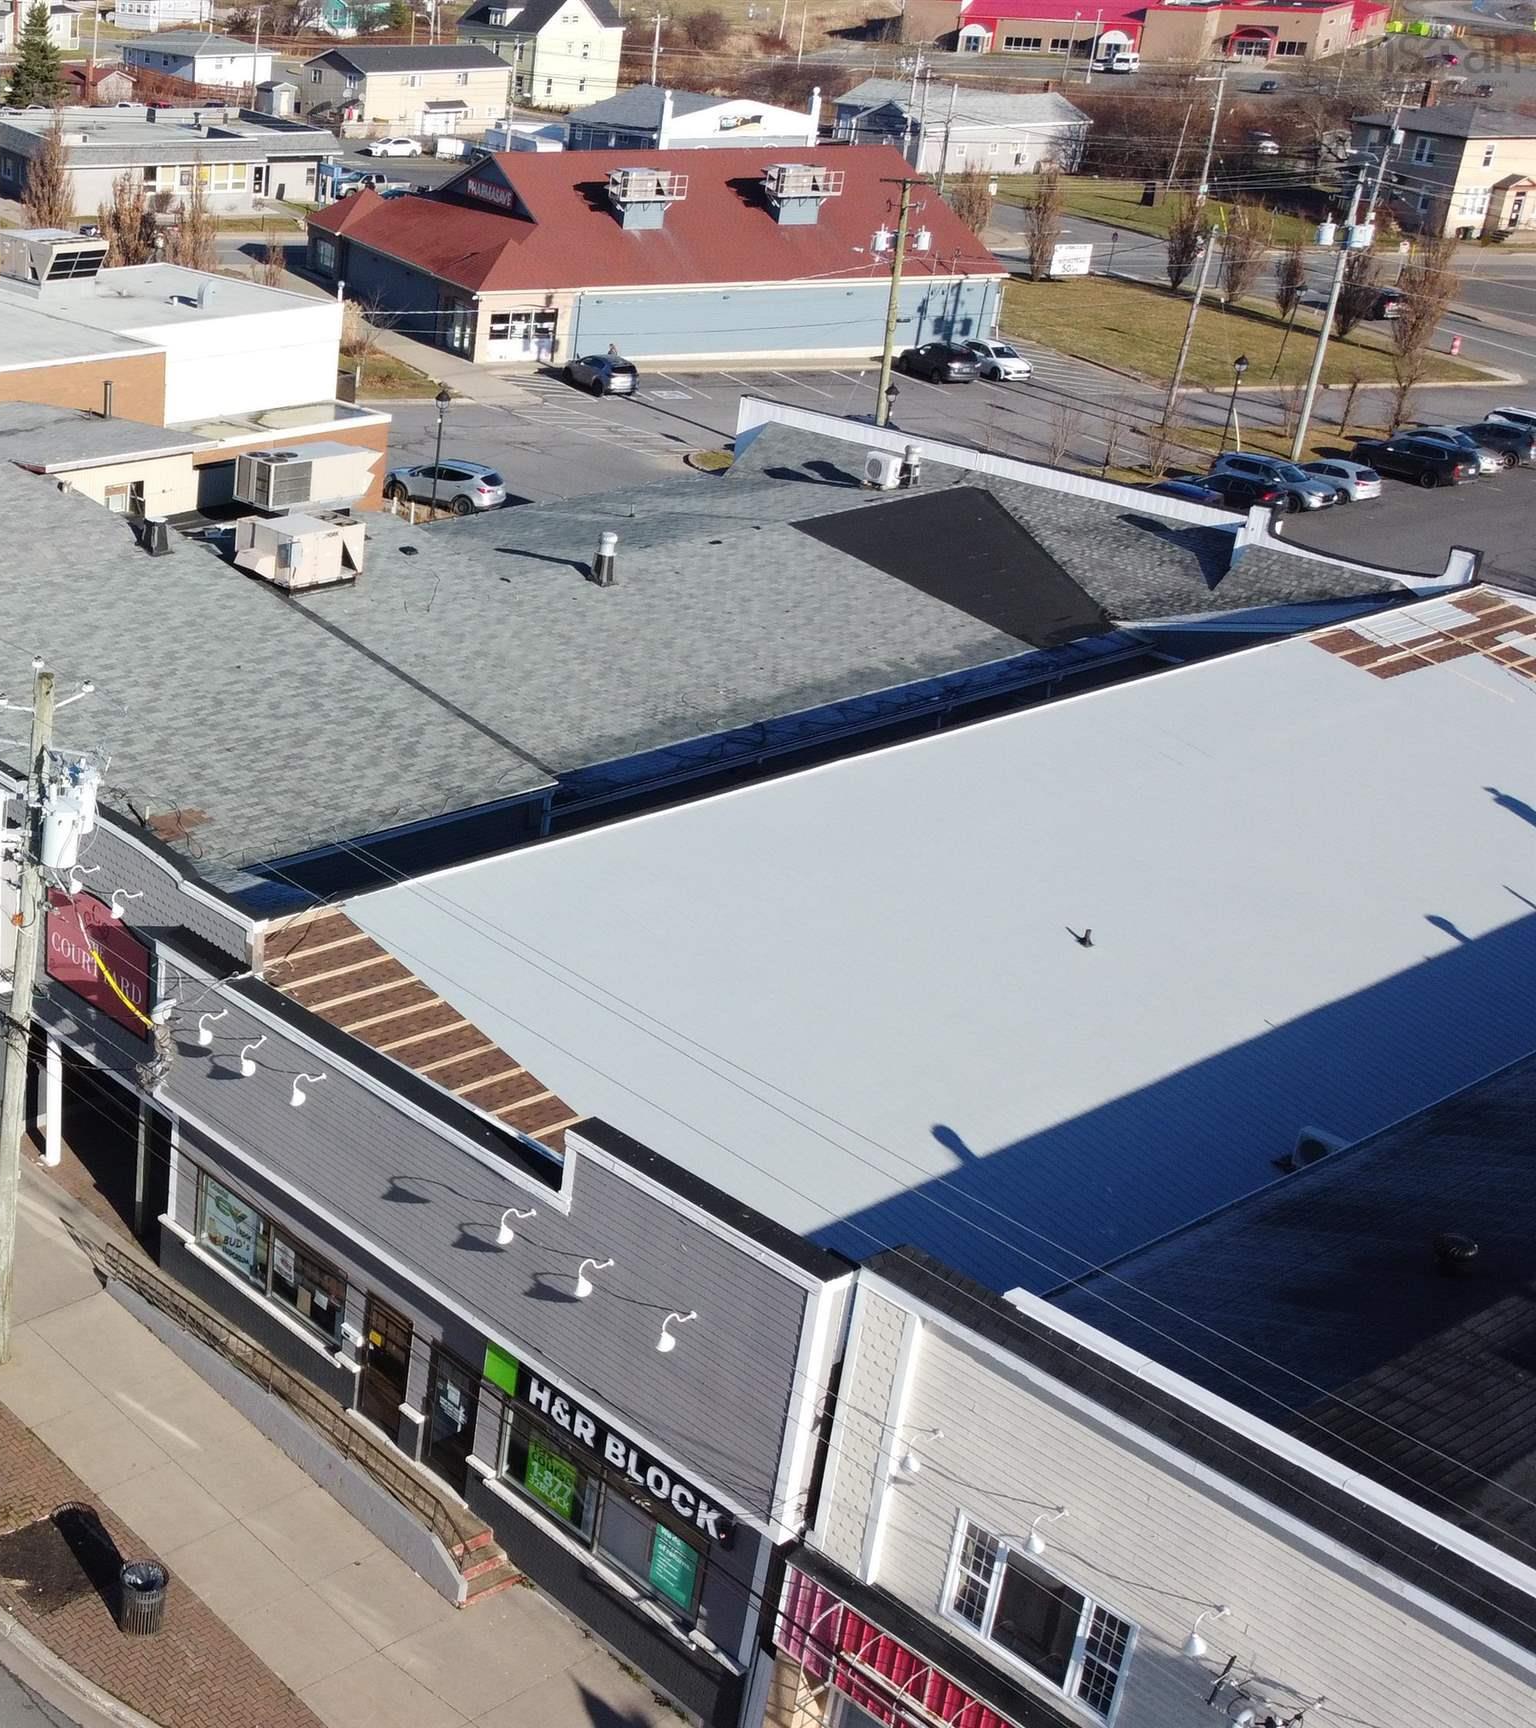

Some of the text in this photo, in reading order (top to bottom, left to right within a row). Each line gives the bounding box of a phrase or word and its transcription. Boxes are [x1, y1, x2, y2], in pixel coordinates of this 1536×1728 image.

[528, 1376, 724, 1541] H&R BLOCK
[531, 1461, 572, 1500] 1-877
